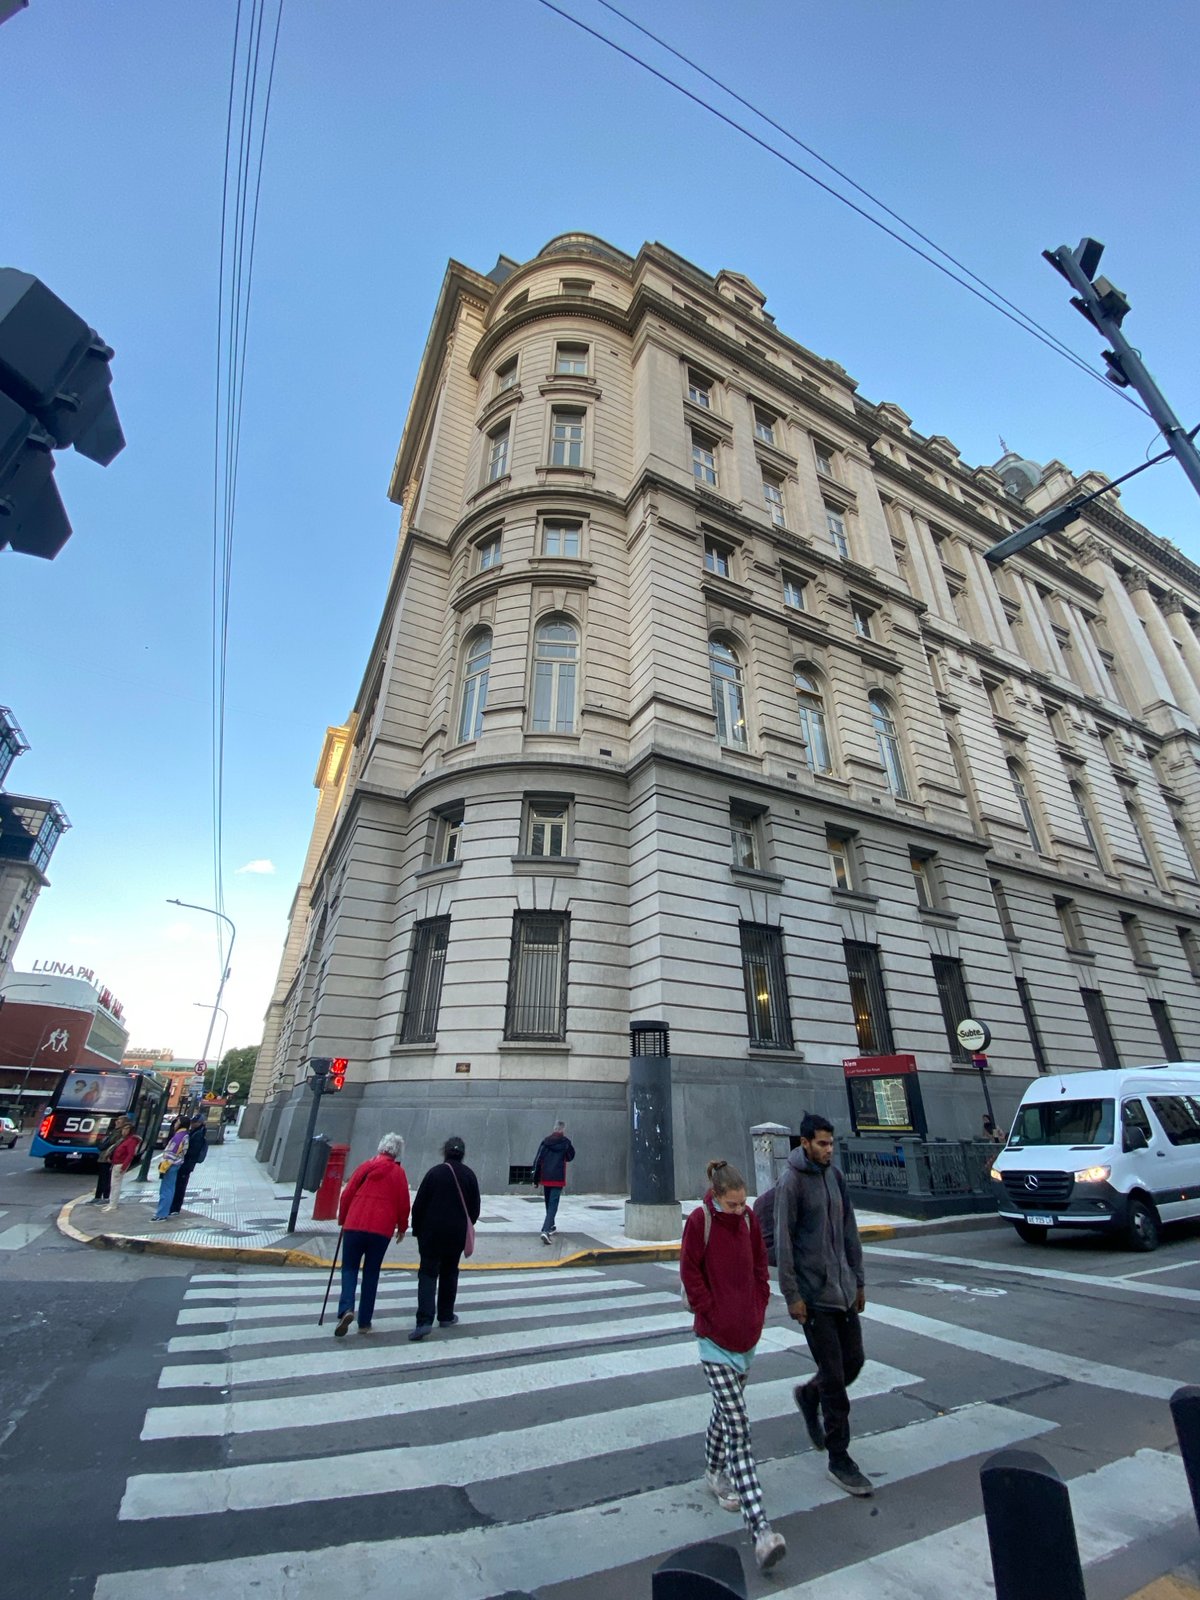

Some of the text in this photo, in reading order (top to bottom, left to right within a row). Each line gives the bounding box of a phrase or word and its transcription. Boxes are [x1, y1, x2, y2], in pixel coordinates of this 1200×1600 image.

[32, 959, 75, 977] LUNA
[960, 1028, 981, 1038] Subte
[64, 1117, 96, 1133] 50
